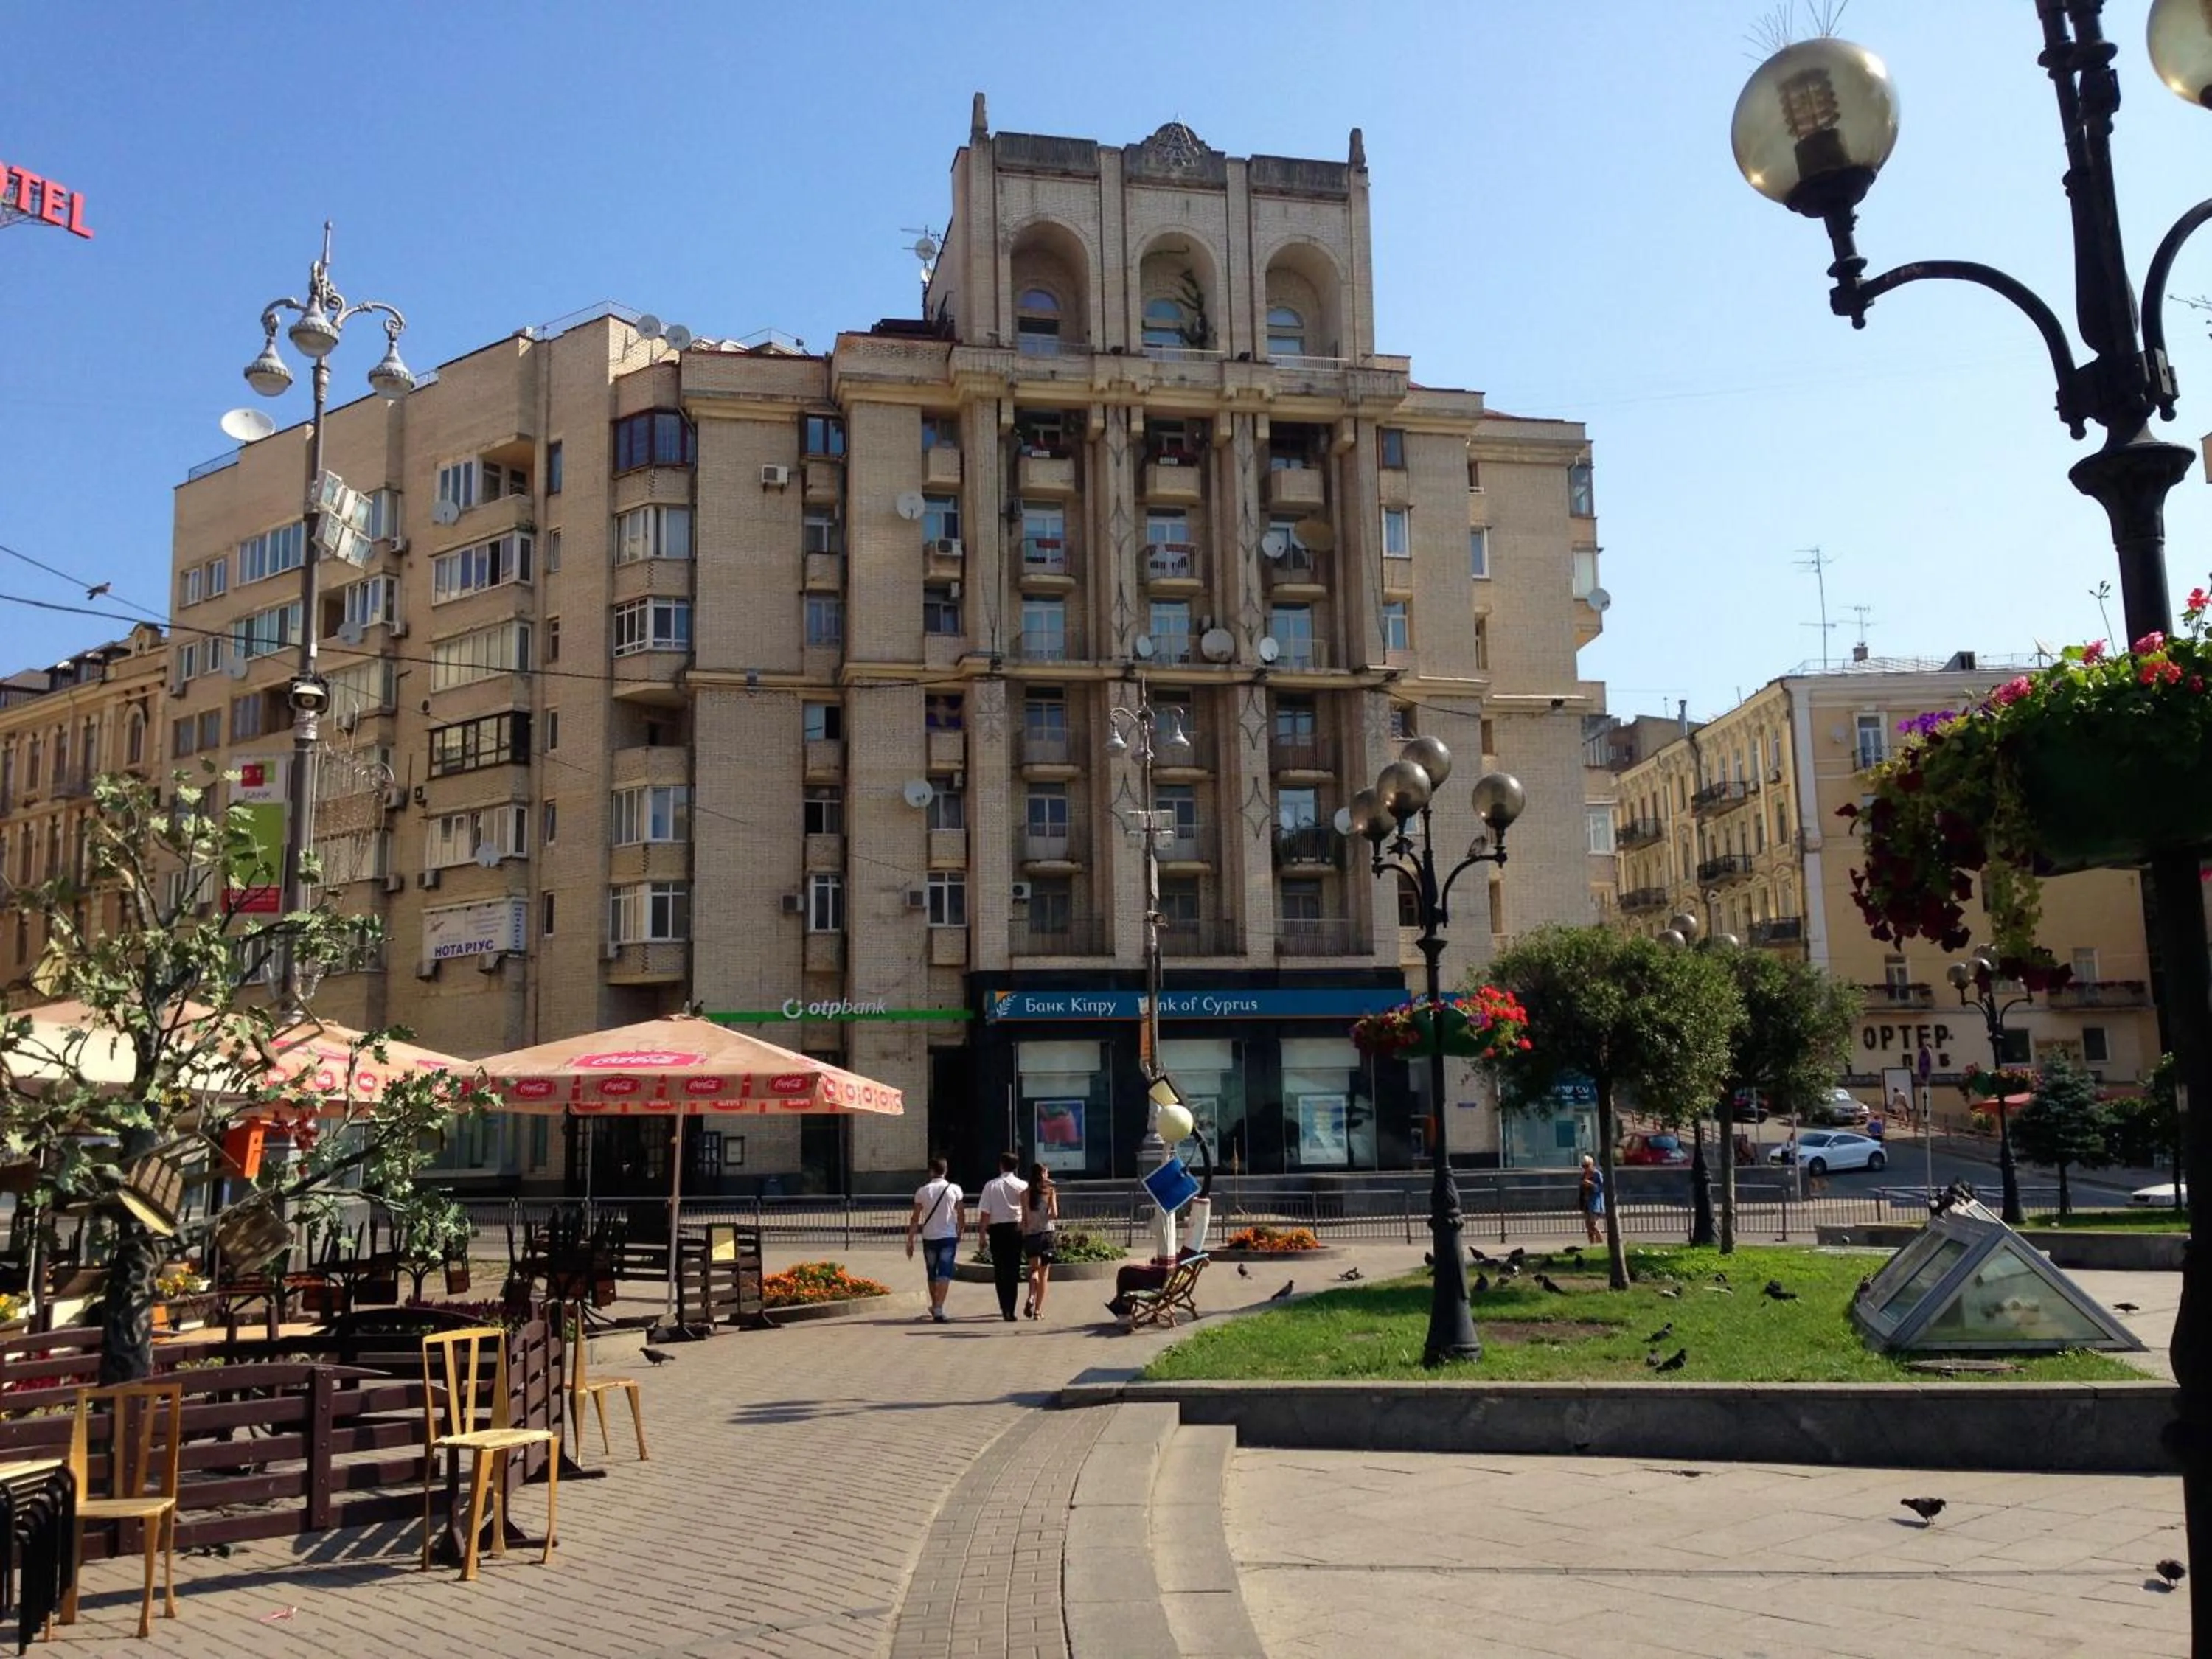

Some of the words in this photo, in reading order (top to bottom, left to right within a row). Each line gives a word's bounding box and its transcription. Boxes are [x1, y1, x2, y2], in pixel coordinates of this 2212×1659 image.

[0, 160, 94, 240] TEL
[434, 939, 494, 957] НОТАРІУС
[808, 997, 886, 1020] otpbank
[1026, 998, 1065, 1012] Банк
[1071, 998, 1116, 1017] Кіпру
[1181, 997, 1198, 1011] of
[1203, 997, 1258, 1015] Cyprus
